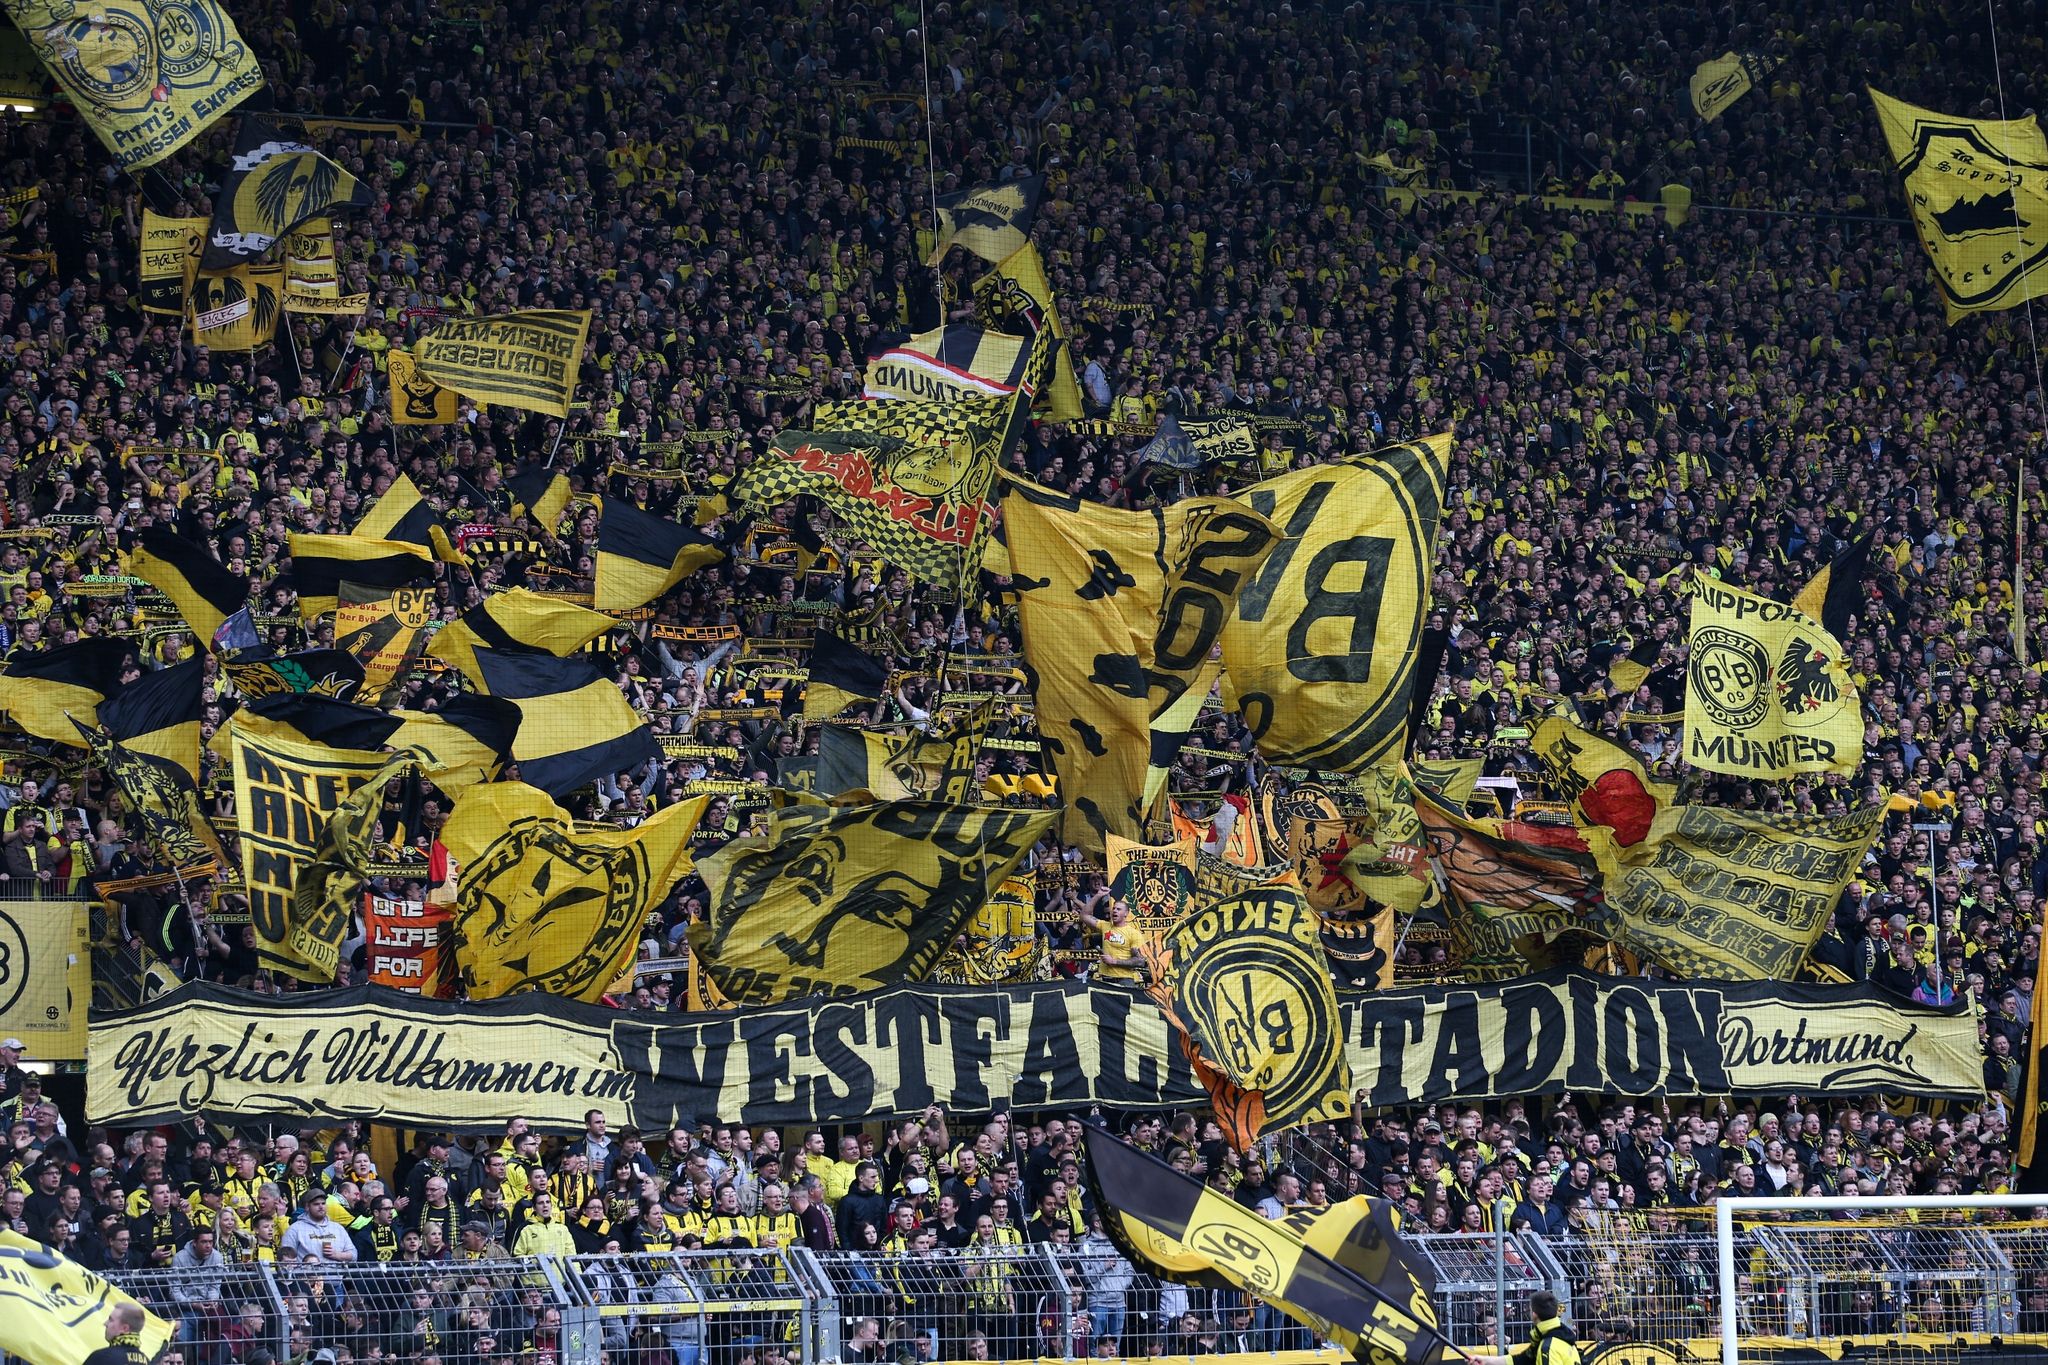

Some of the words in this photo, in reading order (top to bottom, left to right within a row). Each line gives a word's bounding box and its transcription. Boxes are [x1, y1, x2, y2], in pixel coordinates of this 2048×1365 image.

[159, 12, 194, 51] BVB
[162, 31, 212, 73] DORTMUND
[191, 65, 262, 120] EXPRESS
[112, 105, 175, 149] PITTI'S
[112, 115, 194, 169] BORUSSEN
[1185, 416, 1241, 441] BLACK
[1199, 437, 1251, 463] STARS
[398, 589, 434, 614] BVB
[339, 612, 356, 621] Der
[408, 612, 422, 624] 09
[1691, 630, 1757, 661] BORUSSIA
[1704, 652, 1753, 693] BVB
[1727, 690, 1746, 704] 09
[1691, 727, 1838, 771] MÜNSTER
[1126, 849, 1149, 861] THE
[1151, 849, 1182, 861] UNITY
[1146, 880, 1165, 897] BVB
[372, 895, 424, 918] ONE
[374, 925, 438, 948] LIFE
[373, 955, 423, 978] FOR
[113, 1020, 321, 1112] Herzlich
[321, 1019, 582, 1094] Willkommen
[584, 1043, 638, 1102] im
